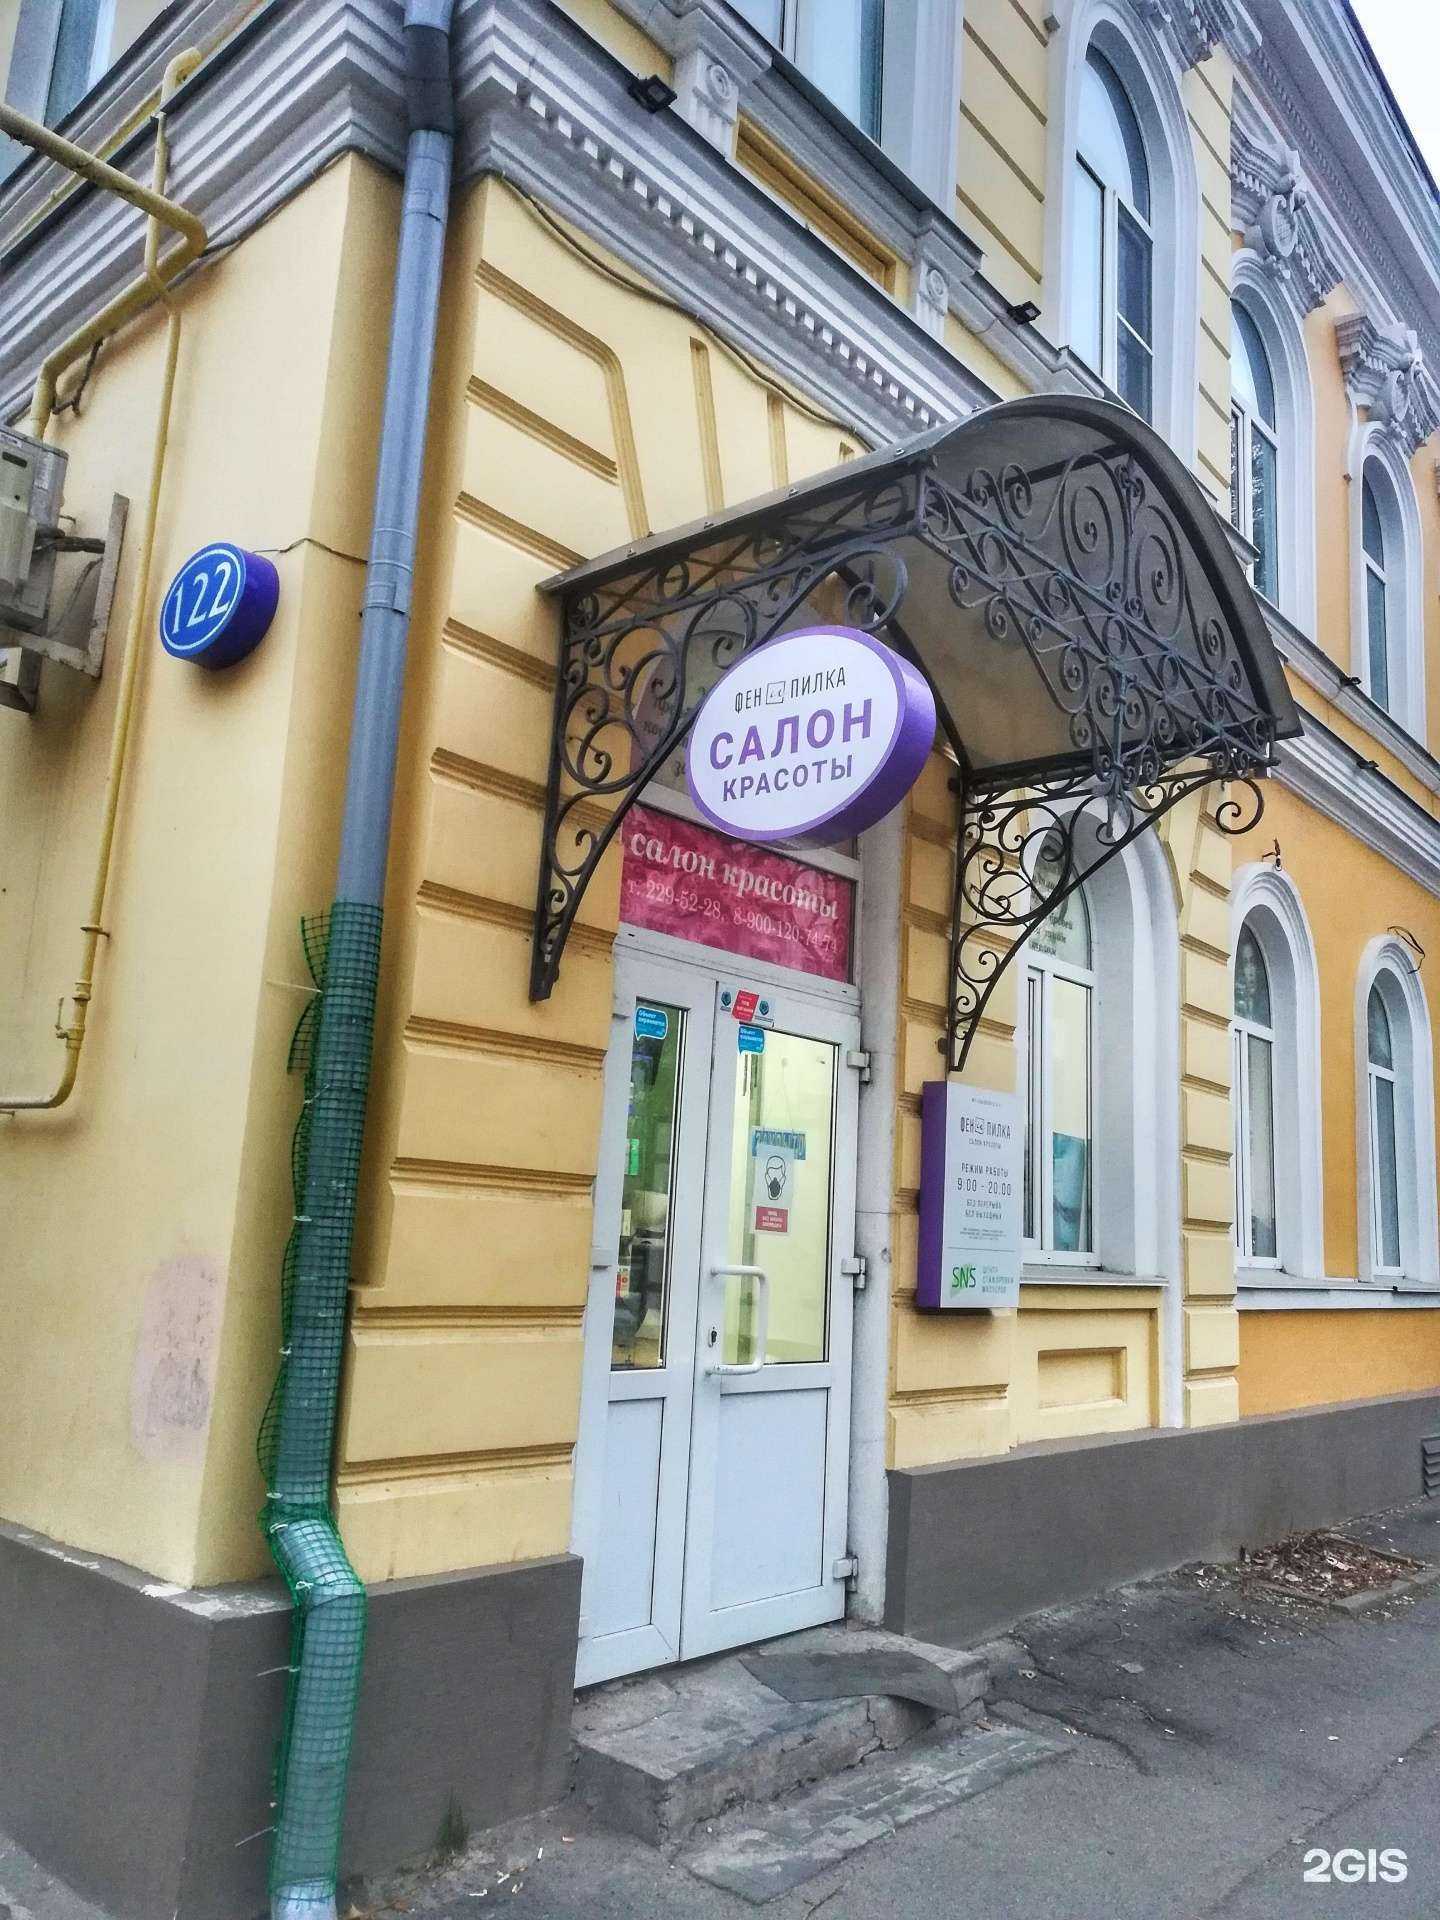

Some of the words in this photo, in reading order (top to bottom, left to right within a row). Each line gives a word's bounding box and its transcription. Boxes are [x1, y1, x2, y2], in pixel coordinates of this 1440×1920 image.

[172, 561, 231, 635] 122
[735, 687, 763, 714] ФЕН
[790, 666, 846, 698] ПИЛКА
[709, 698, 873, 770] САЛОН
[722, 755, 853, 802] КРАСОТЫ
[629, 831, 716, 880] салон
[722, 861, 839, 920] красоты
[960, 1116, 975, 1133] ФЕН
[986, 1121, 1012, 1140] ПИЛКА
[961, 1162, 983, 1174] РЕЖИМ
[985, 1166, 1009, 1178] РАБОТЫ
[952, 1266, 976, 1288] SNS
